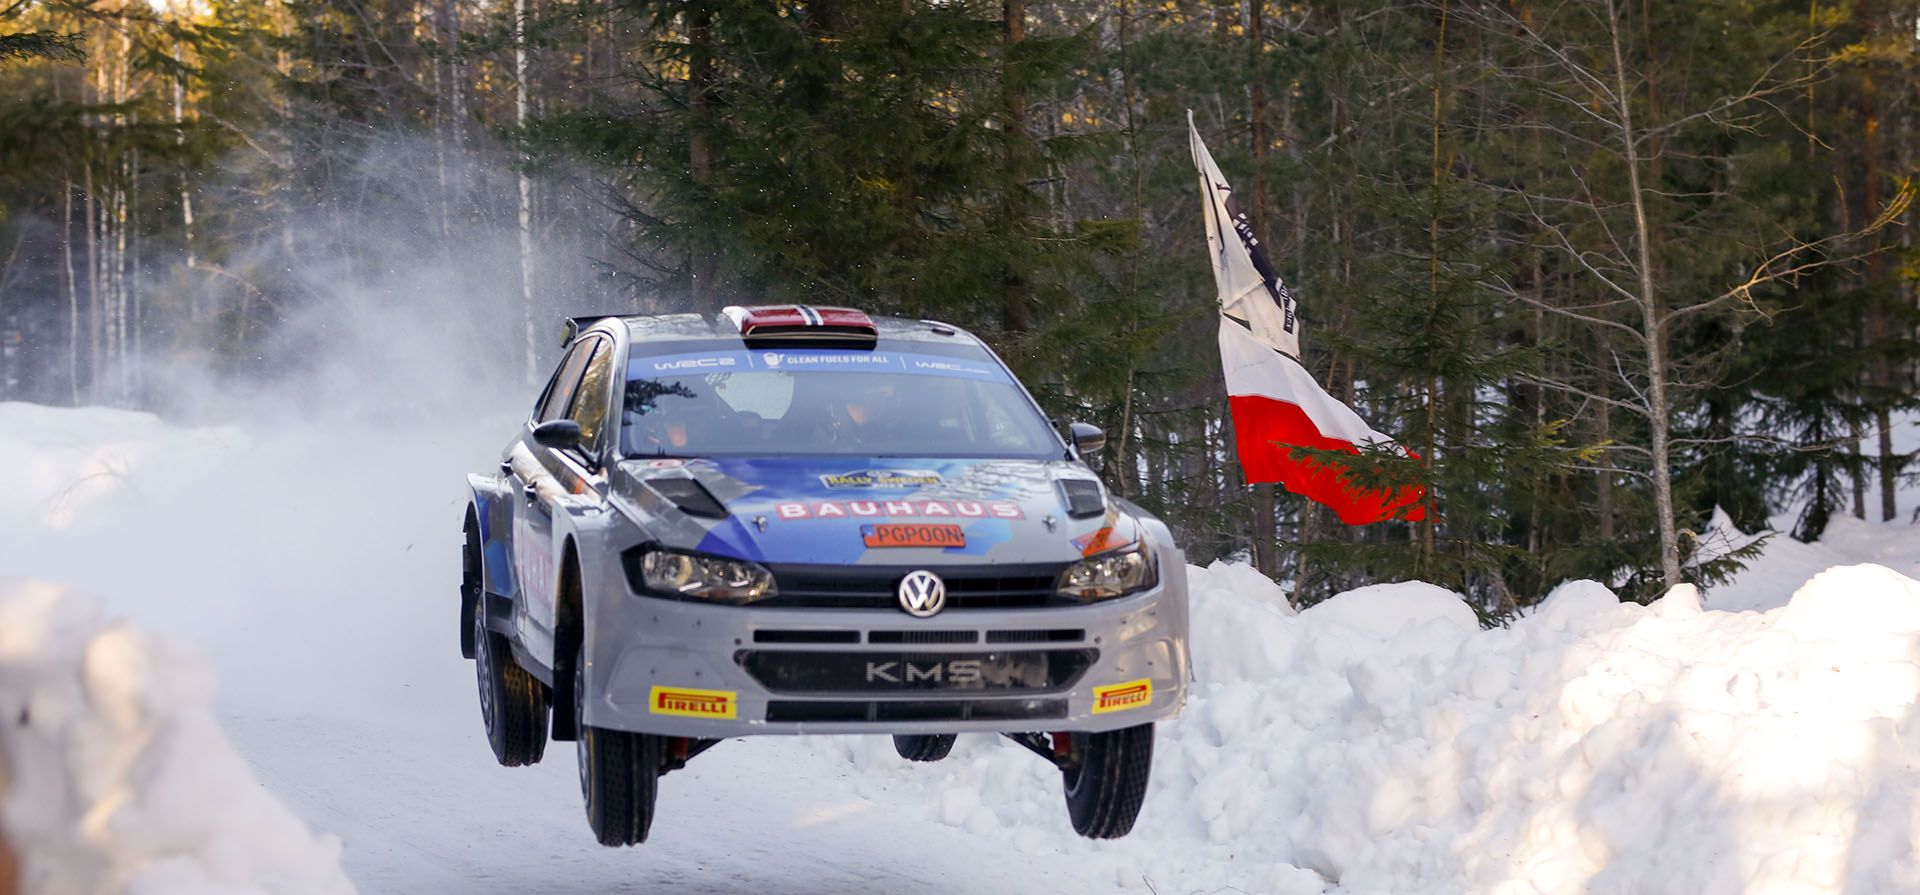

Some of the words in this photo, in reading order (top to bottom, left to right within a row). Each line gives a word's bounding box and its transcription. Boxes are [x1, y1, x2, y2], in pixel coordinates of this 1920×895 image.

[654, 357, 736, 370] WRC2
[787, 356, 818, 364] CLEAN
[820, 355, 849, 364] FUELS
[851, 355, 869, 363] FOR
[872, 355, 888, 363] ALL
[829, 476, 872, 484] RALLY
[878, 476, 939, 484] SWEDEN
[778, 501, 1022, 519] BAUHAUS
[866, 660, 981, 682] KMS
[658, 692, 728, 713] PIRELLI
[1099, 685, 1147, 708] PIRELLI
